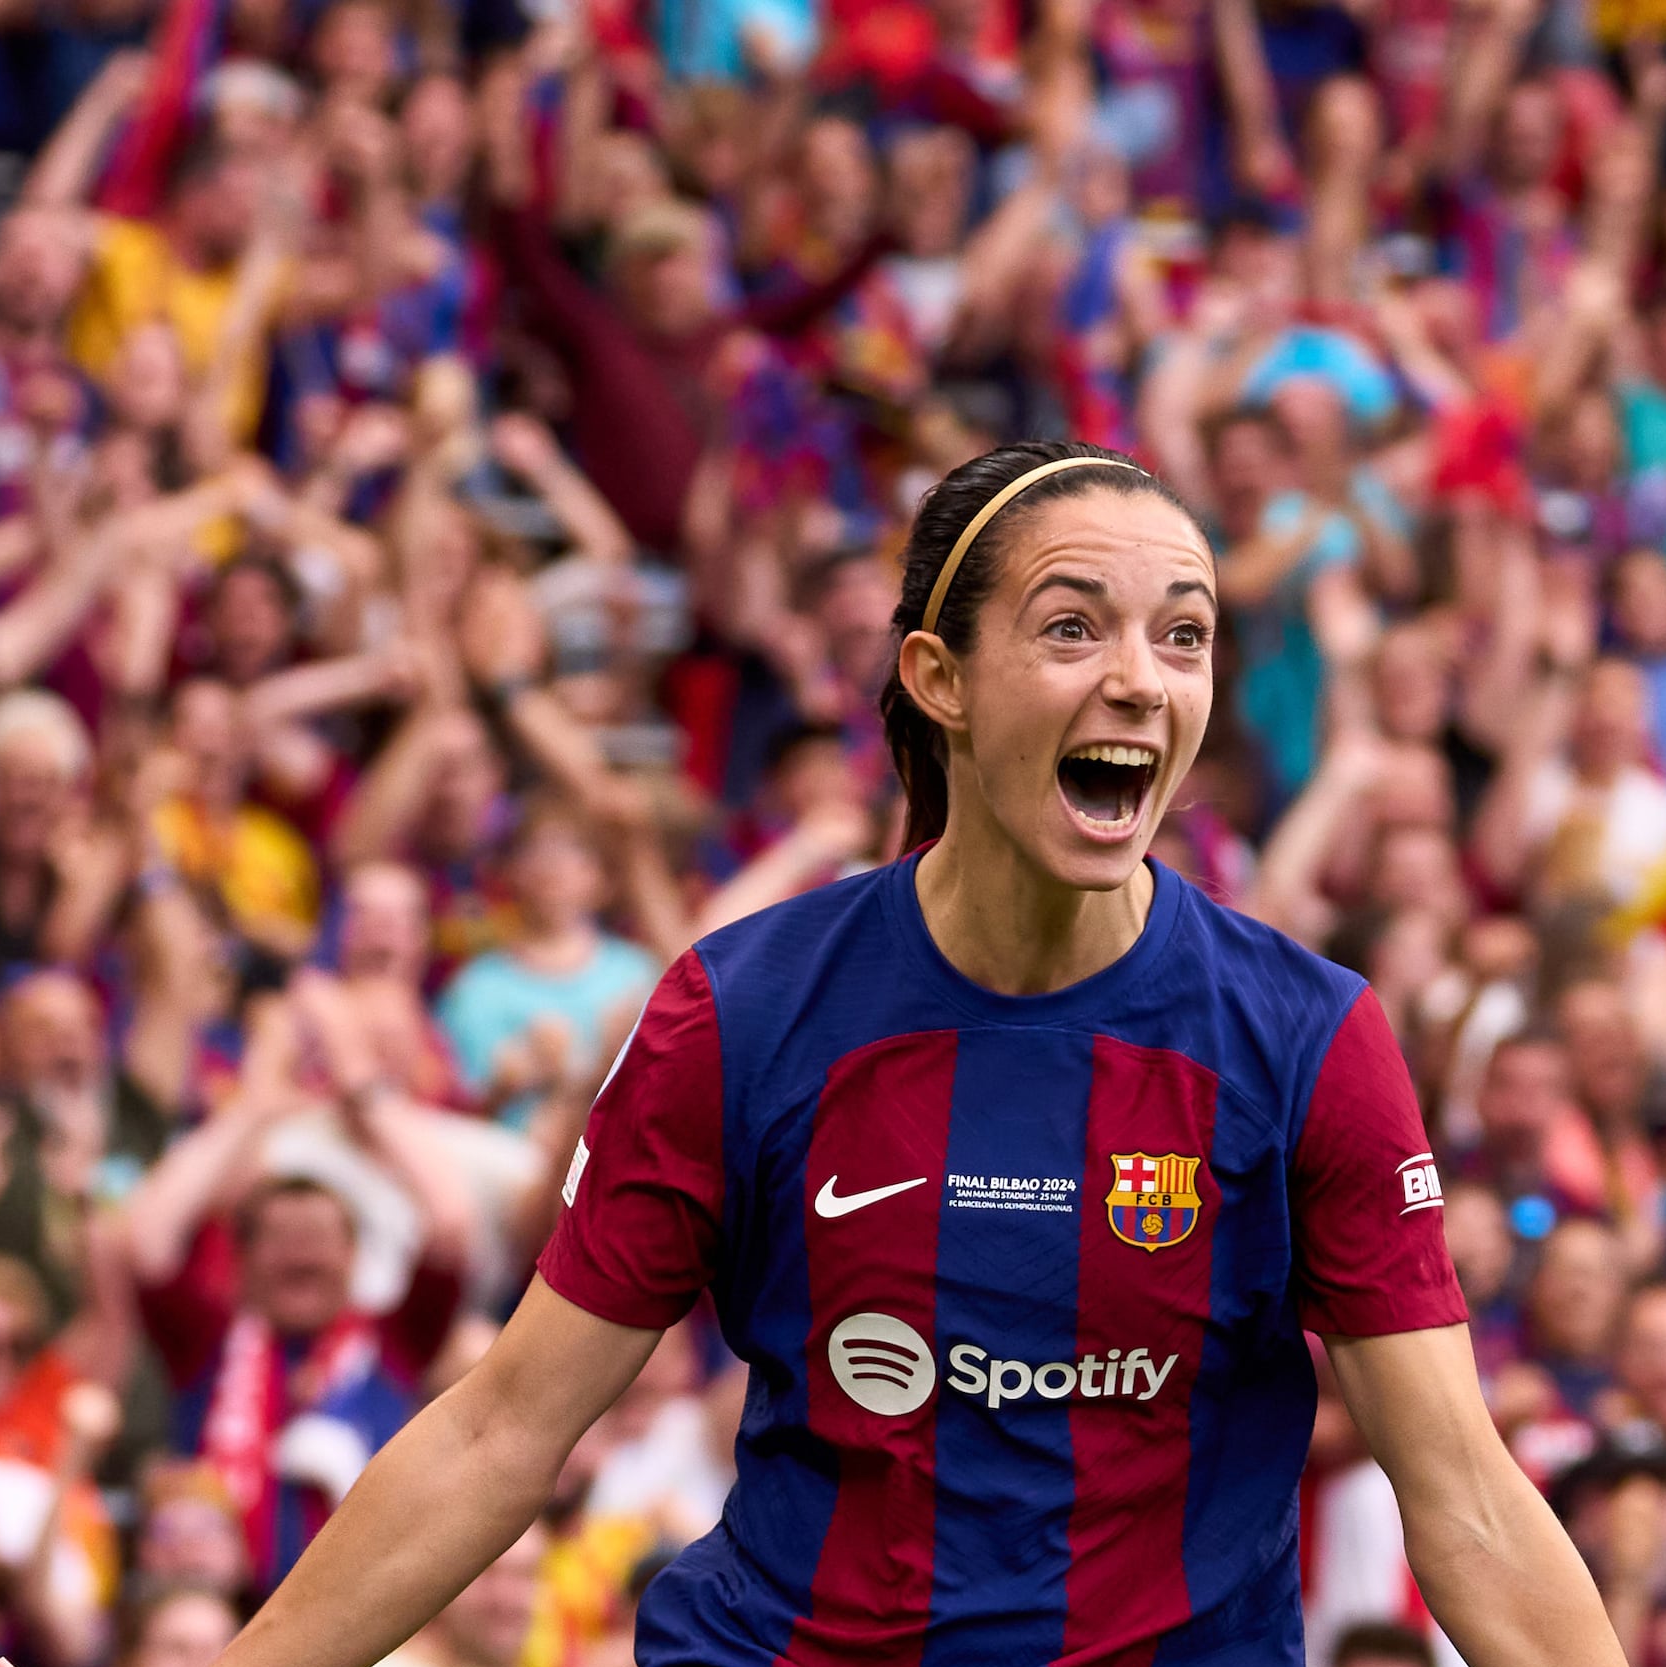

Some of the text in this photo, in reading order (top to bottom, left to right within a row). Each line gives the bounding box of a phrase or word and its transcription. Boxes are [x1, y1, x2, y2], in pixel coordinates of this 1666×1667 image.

[948, 1174, 1076, 1192] FINAL BILBAO 2024
[956, 1189, 973, 1198] SAN
[973, 1190, 1000, 1199] MAMÉS
[1000, 1192, 1035, 1200] STADIUM
[1039, 1193, 1049, 1201] 25
[1050, 1193, 1067, 1202] MAY
[1136, 1194, 1172, 1206] FCB
[949, 1200, 957, 1208] FC
[957, 1201, 996, 1209] BARCELONA
[1003, 1202, 1041, 1211] OLYMPIQUE
[1041, 1204, 1073, 1213] LYONNAIS
[946, 1344, 1179, 1409] Spotify
